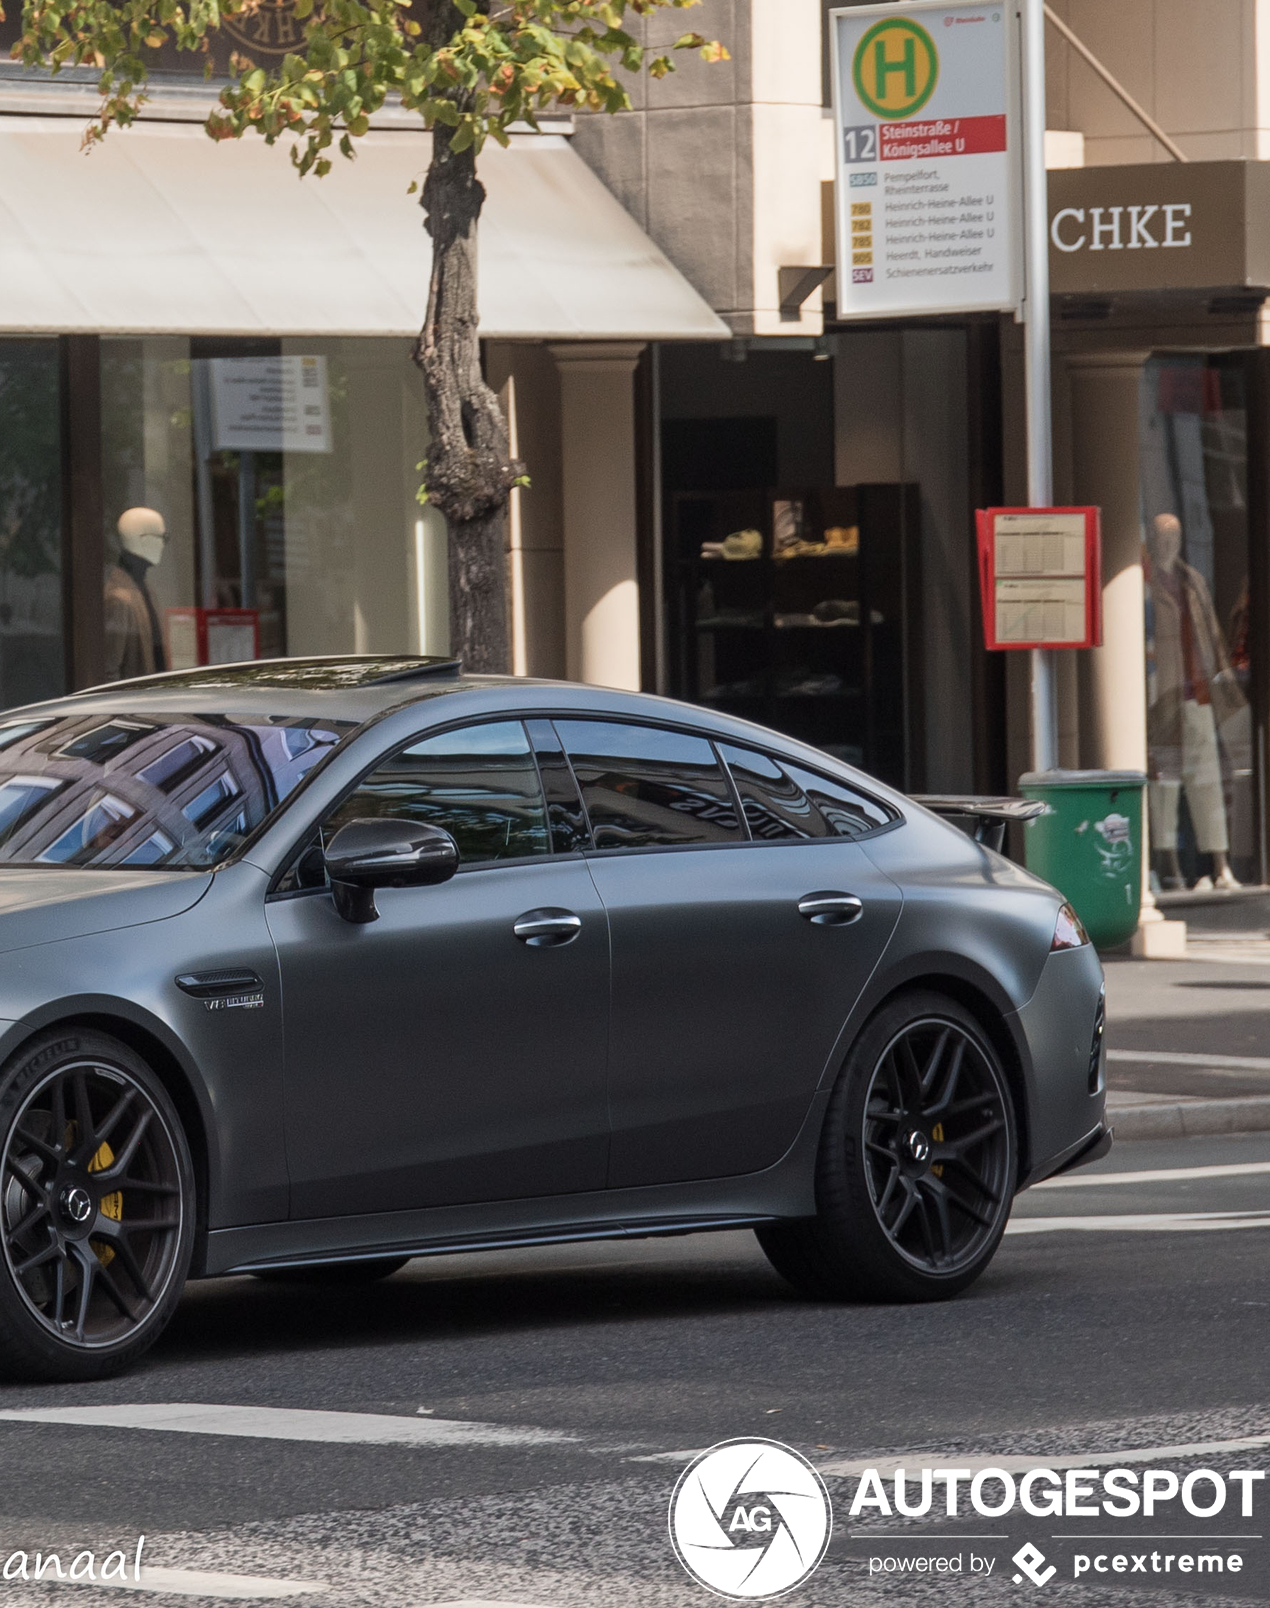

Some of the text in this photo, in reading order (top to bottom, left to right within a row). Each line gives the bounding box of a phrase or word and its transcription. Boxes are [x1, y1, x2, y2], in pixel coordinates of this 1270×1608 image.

[875, 38, 916, 99] H
[882, 120, 960, 140] Steinstraße /
[845, 129, 875, 160] 12
[883, 138, 965, 159] Königsallee U
[884, 170, 940, 184] Pempelfort,
[885, 182, 949, 196] Rheinterrasse
[885, 196, 983, 212] Heinrich-Heine-Allee
[985, 194, 994, 205] U
[885, 213, 983, 228] Heinrich-Heine-Allee
[986, 211, 994, 222] U
[1050, 203, 1192, 252] CHKE
[886, 229, 983, 245] Heinrich-Heine-Allee
[986, 228, 995, 239] U
[924, 246, 982, 258] Handweiser
[853, 262, 994, 281] SEV Schienenersatzverkehr
